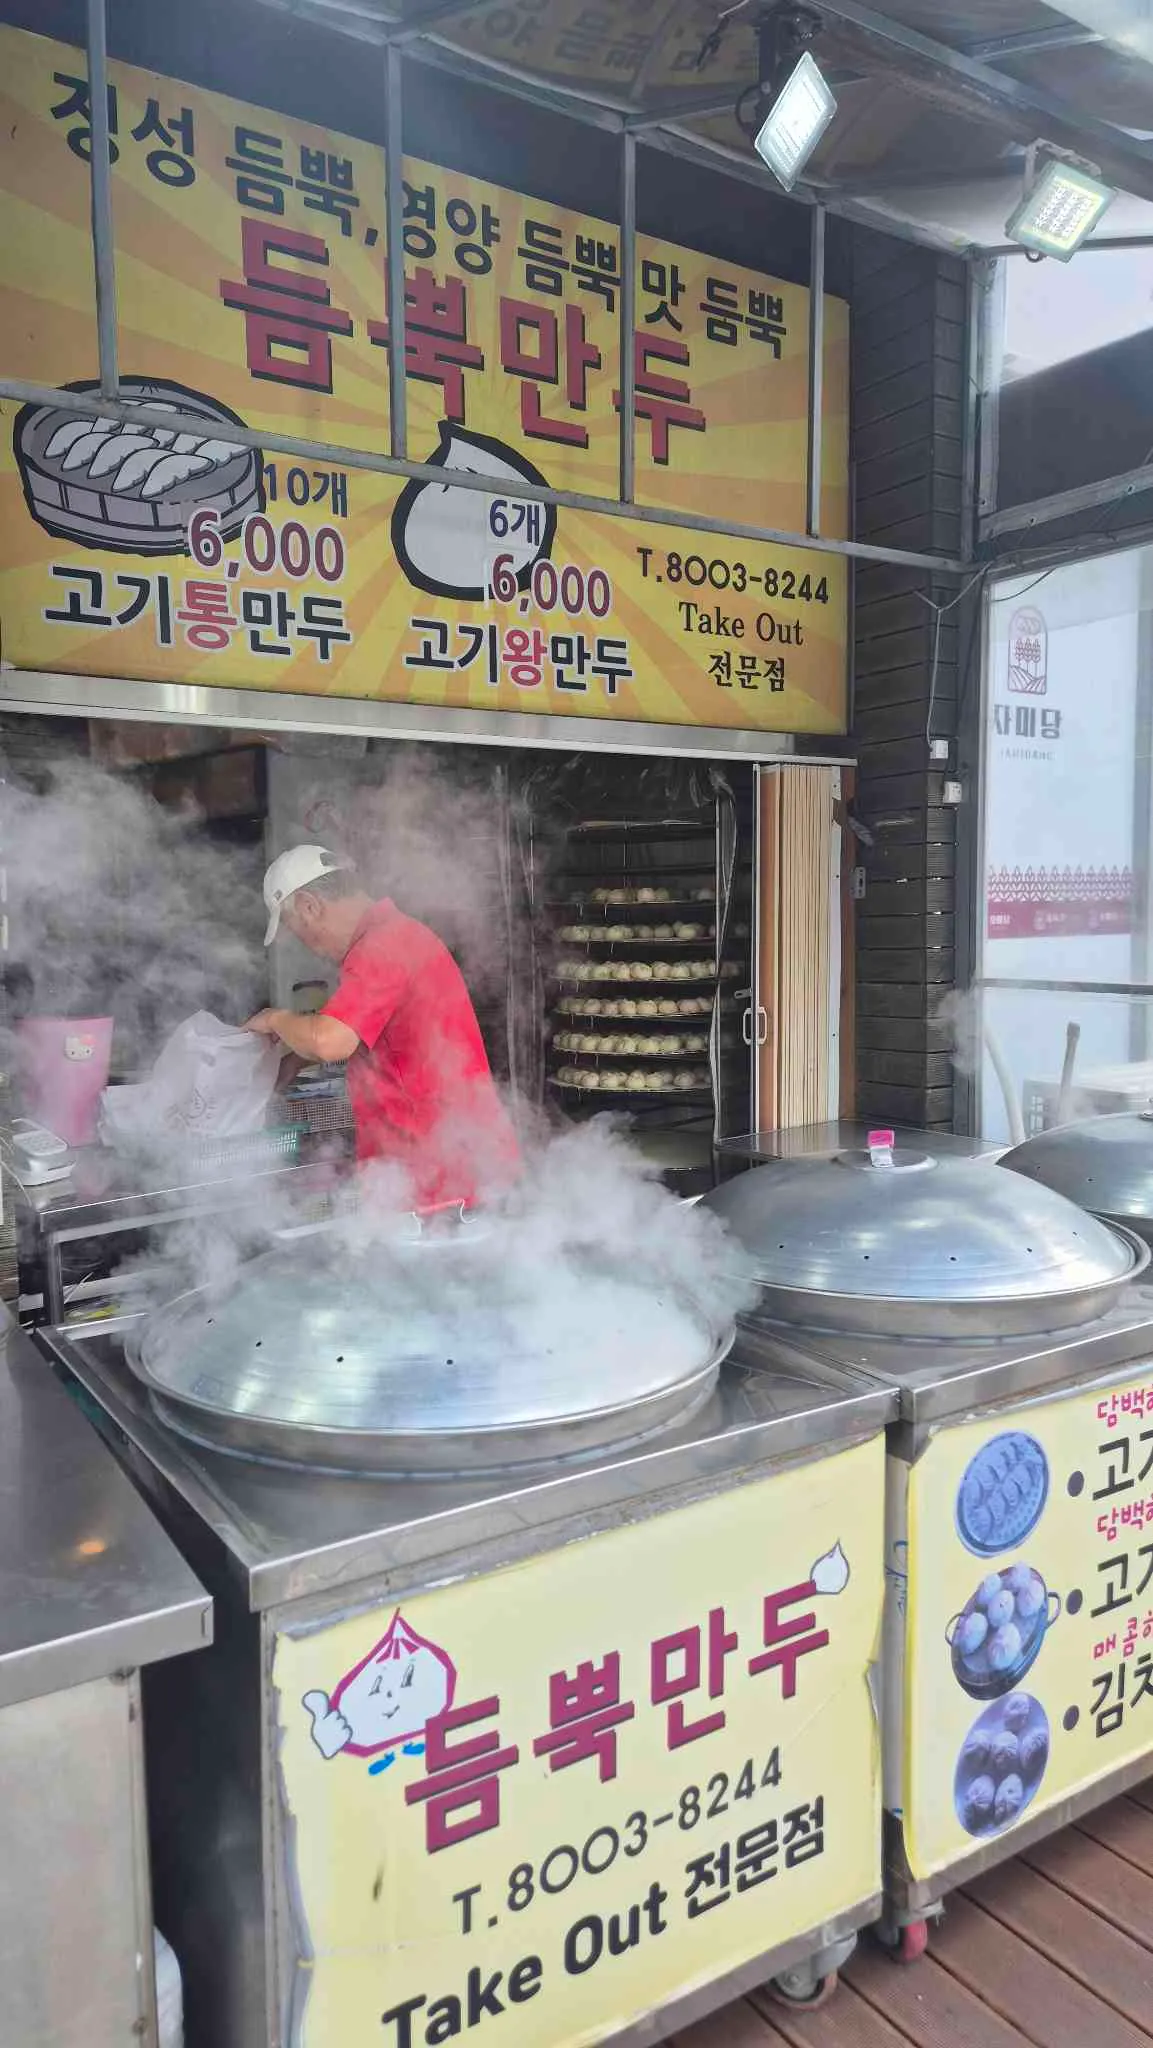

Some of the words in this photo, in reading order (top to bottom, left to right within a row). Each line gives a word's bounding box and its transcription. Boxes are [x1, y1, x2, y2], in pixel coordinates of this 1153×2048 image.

[50, 72, 196, 187] 정성
[641, 260, 686, 332] 맛
[700, 277, 787, 360] 듬뿍
[220, 216, 707, 465] 듬뿍만두
[263, 463, 348, 518] 10개
[489, 499, 540, 546] 6개
[190, 510, 345, 582] 6,000
[636, 546, 830, 604] T.8003-8244
[44, 564, 351, 660] 고기통만두
[492, 553, 611, 618] 6,000
[405, 617, 633, 693] 고기왕만두
[678, 601, 746, 639] Take
[756, 612, 804, 646] Out
[708, 650, 786, 692] 전문점
[405, 1580, 830, 1854] 듬뿍만두
[453, 1746, 783, 1935] T.8003-8244
[381, 1954, 543, 2048] Take
[564, 1881, 668, 1976] Out
[684, 1795, 825, 1920] 전문점
